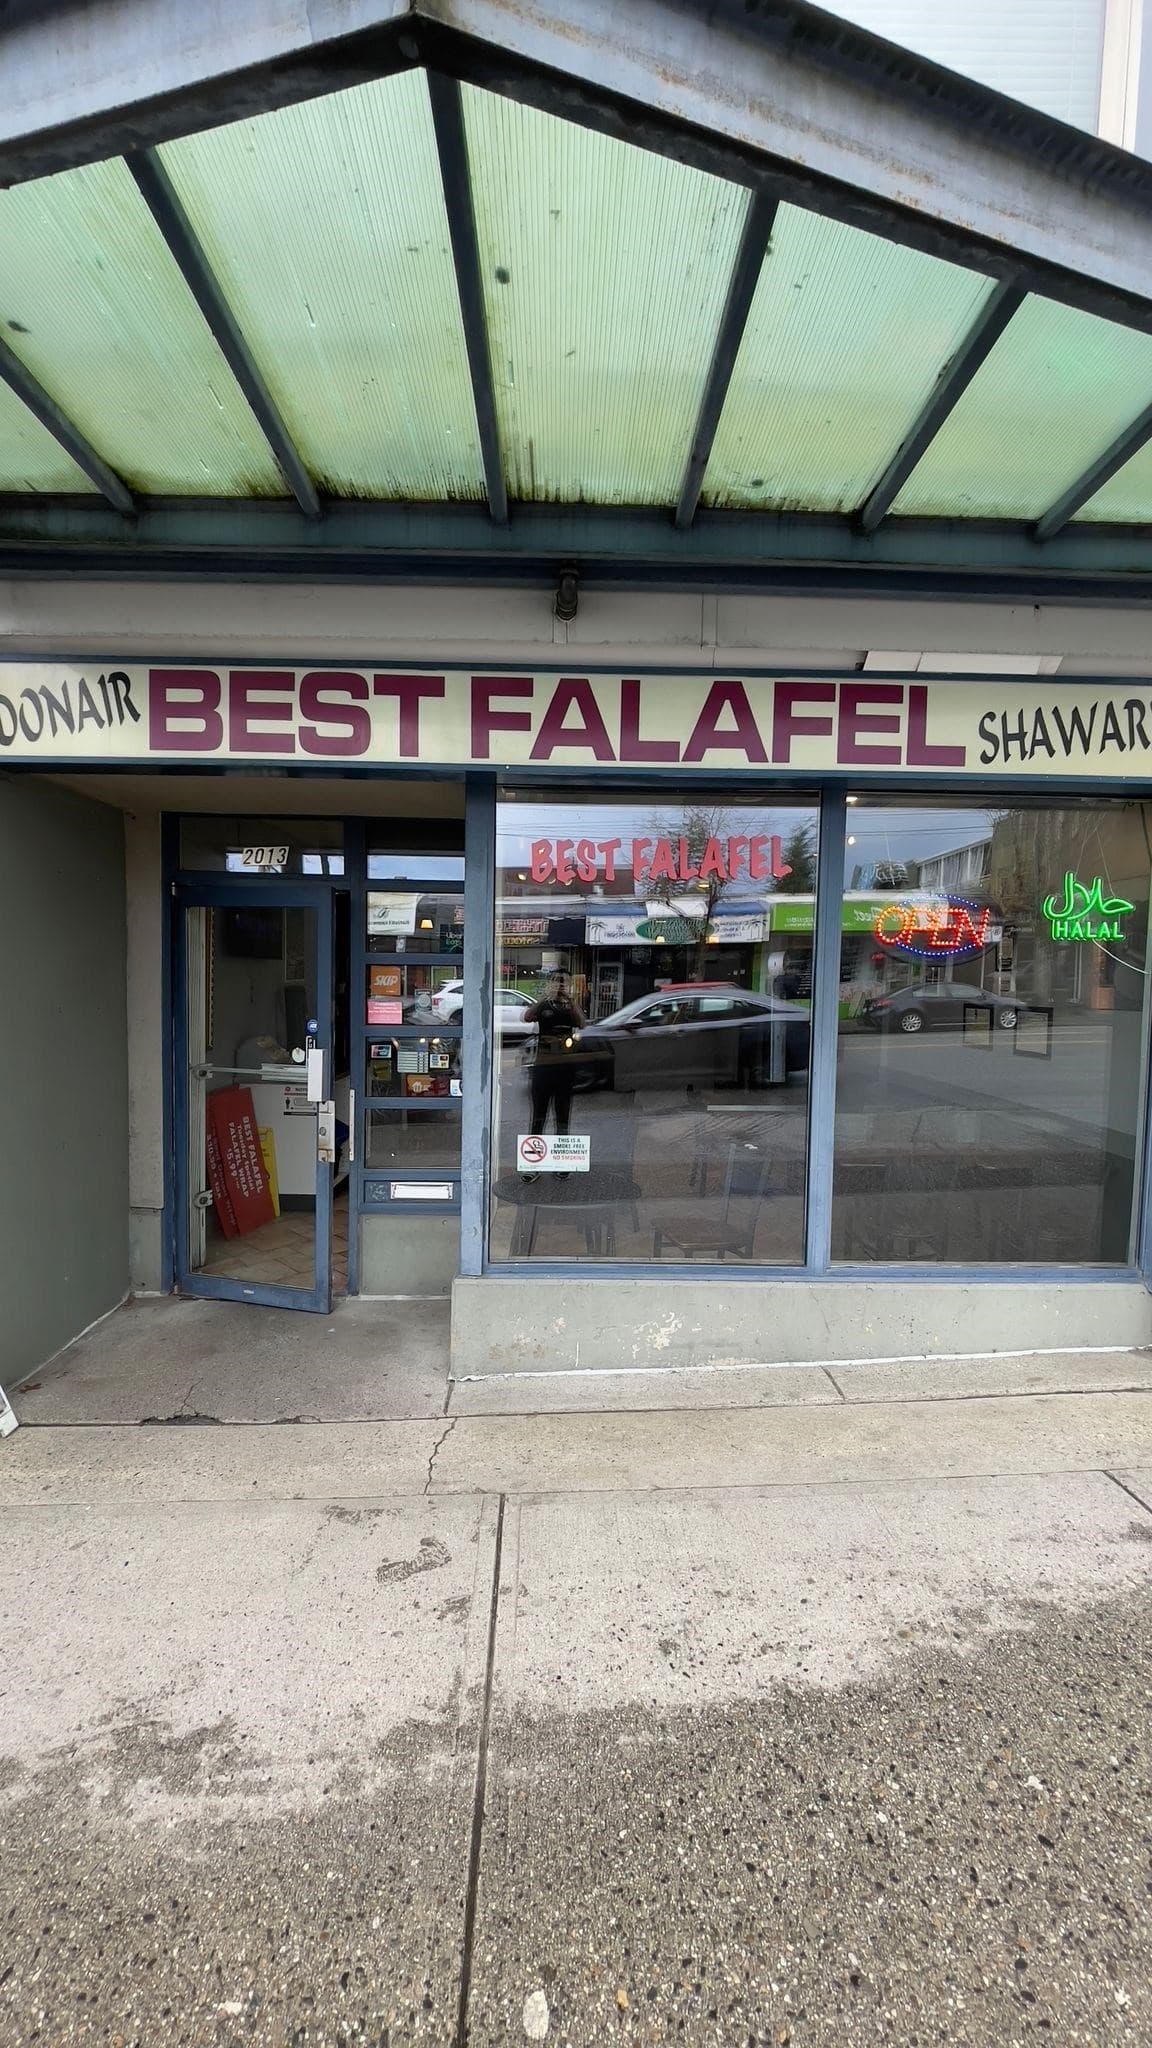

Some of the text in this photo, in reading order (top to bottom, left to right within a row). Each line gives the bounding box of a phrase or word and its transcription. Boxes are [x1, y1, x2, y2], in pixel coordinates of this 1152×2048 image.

[0, 671, 141, 746] DONAIR
[148, 668, 967, 767] BEST FALAFEL
[978, 698, 1152, 765] SHAWAR
[243, 847, 287, 864] 2013
[531, 834, 793, 884] BEST FALAFEL
[1043, 870, 1136, 921] حلال
[875, 905, 990, 949] OPEN
[1053, 920, 1125, 940] HALAL
[374, 975, 398, 986] SKIP
[228, 1121, 242, 1166] FALAFEL
[238, 1167, 249, 1198] WRAP
[242, 1116, 264, 1194] BEST FALAFEL
